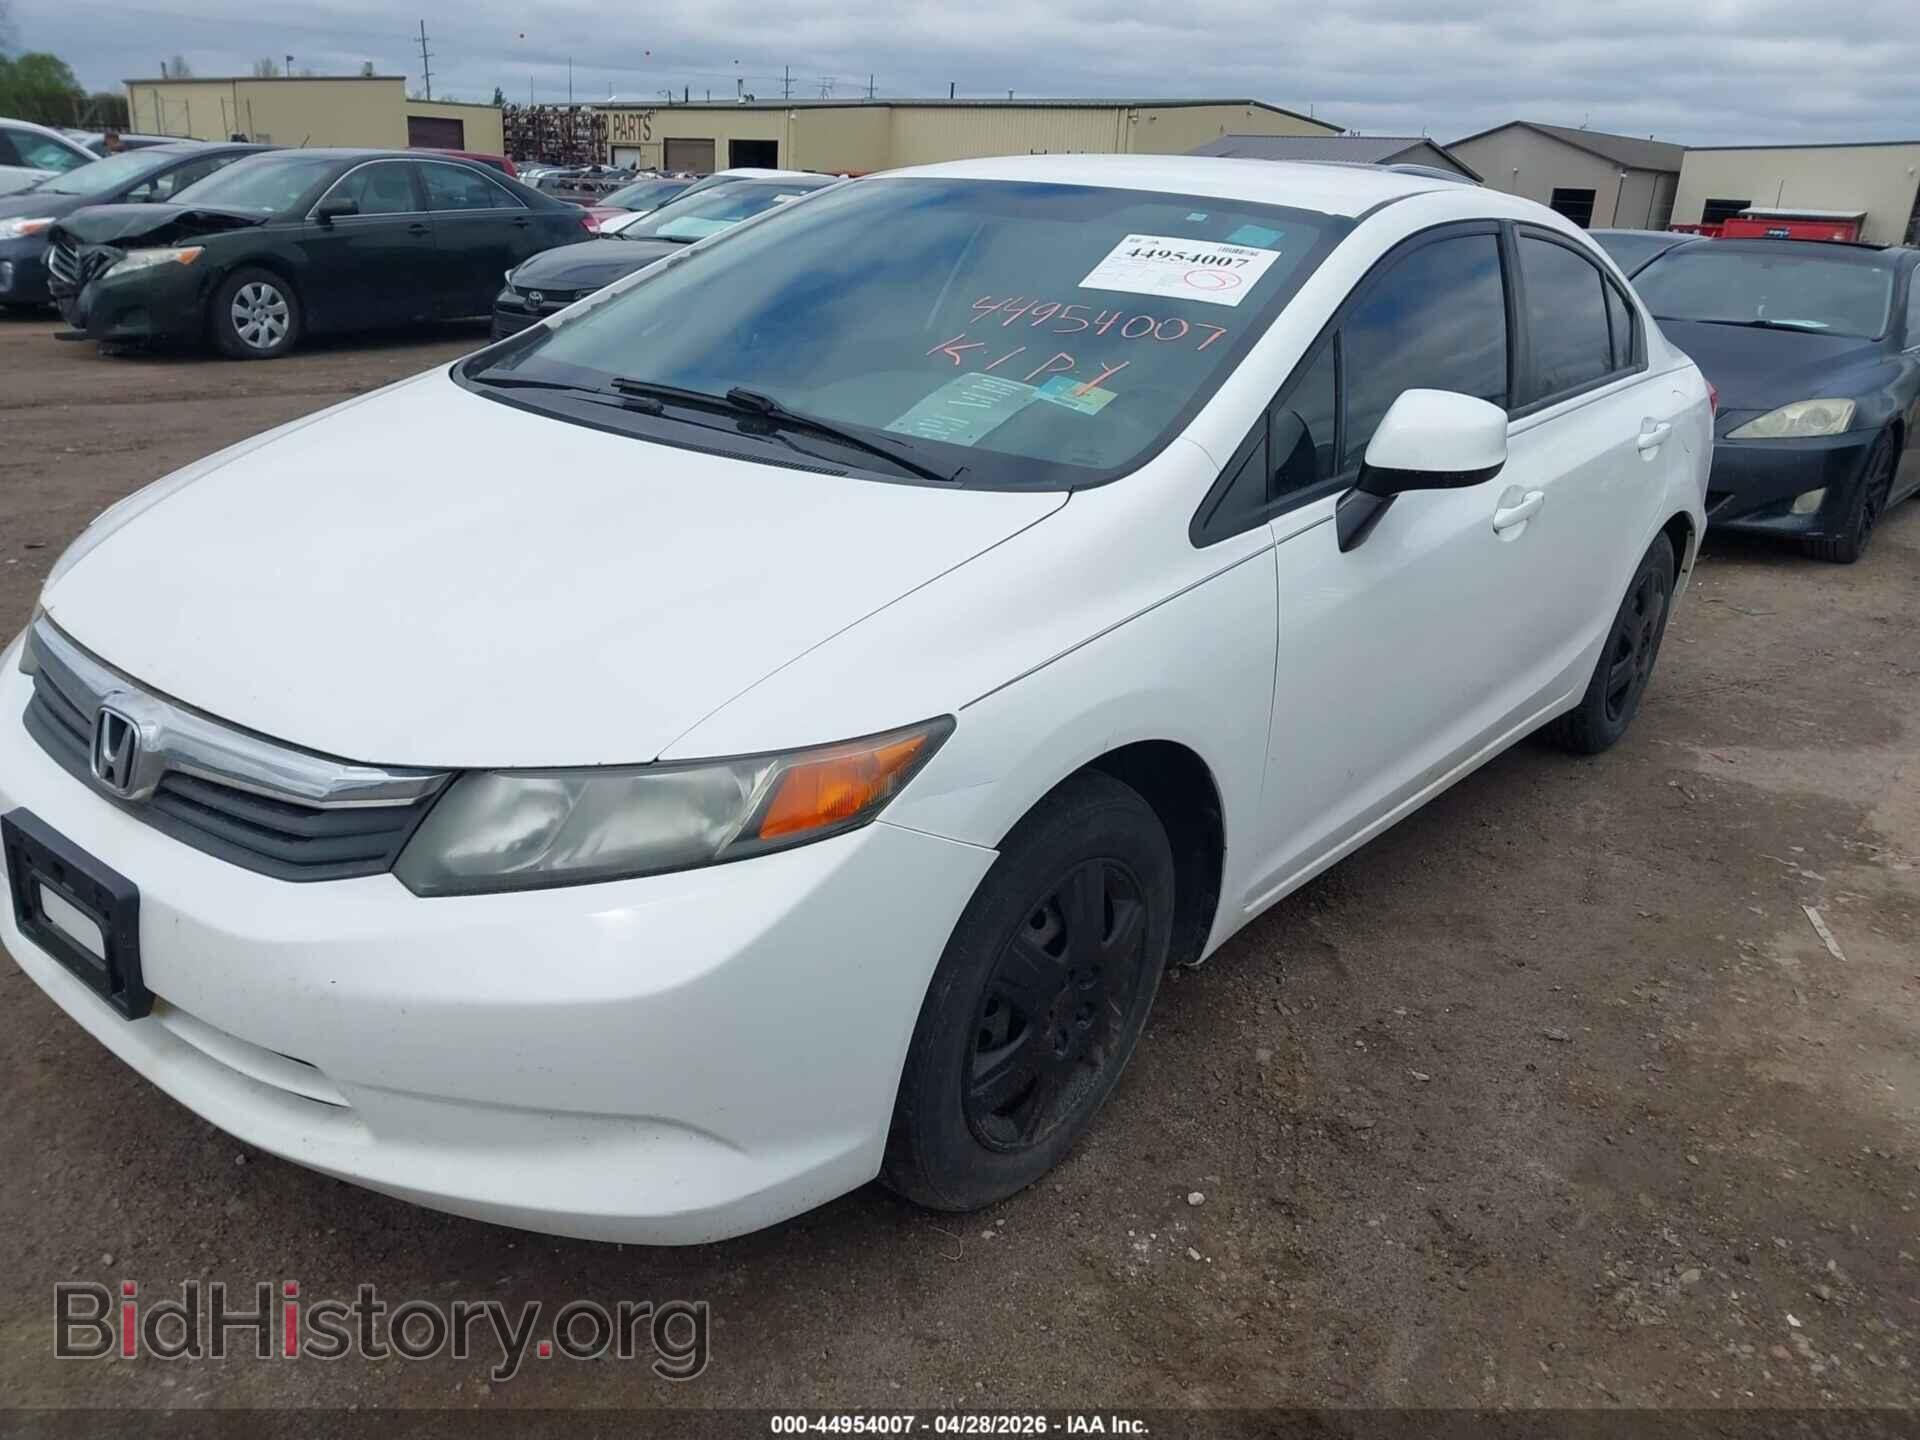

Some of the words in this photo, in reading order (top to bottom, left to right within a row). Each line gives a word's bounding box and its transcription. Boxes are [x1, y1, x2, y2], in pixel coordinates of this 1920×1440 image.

[613, 113, 652, 141] PARTS
[1126, 247, 1249, 269] 44954007
[969, 296, 1227, 350] 44954007
